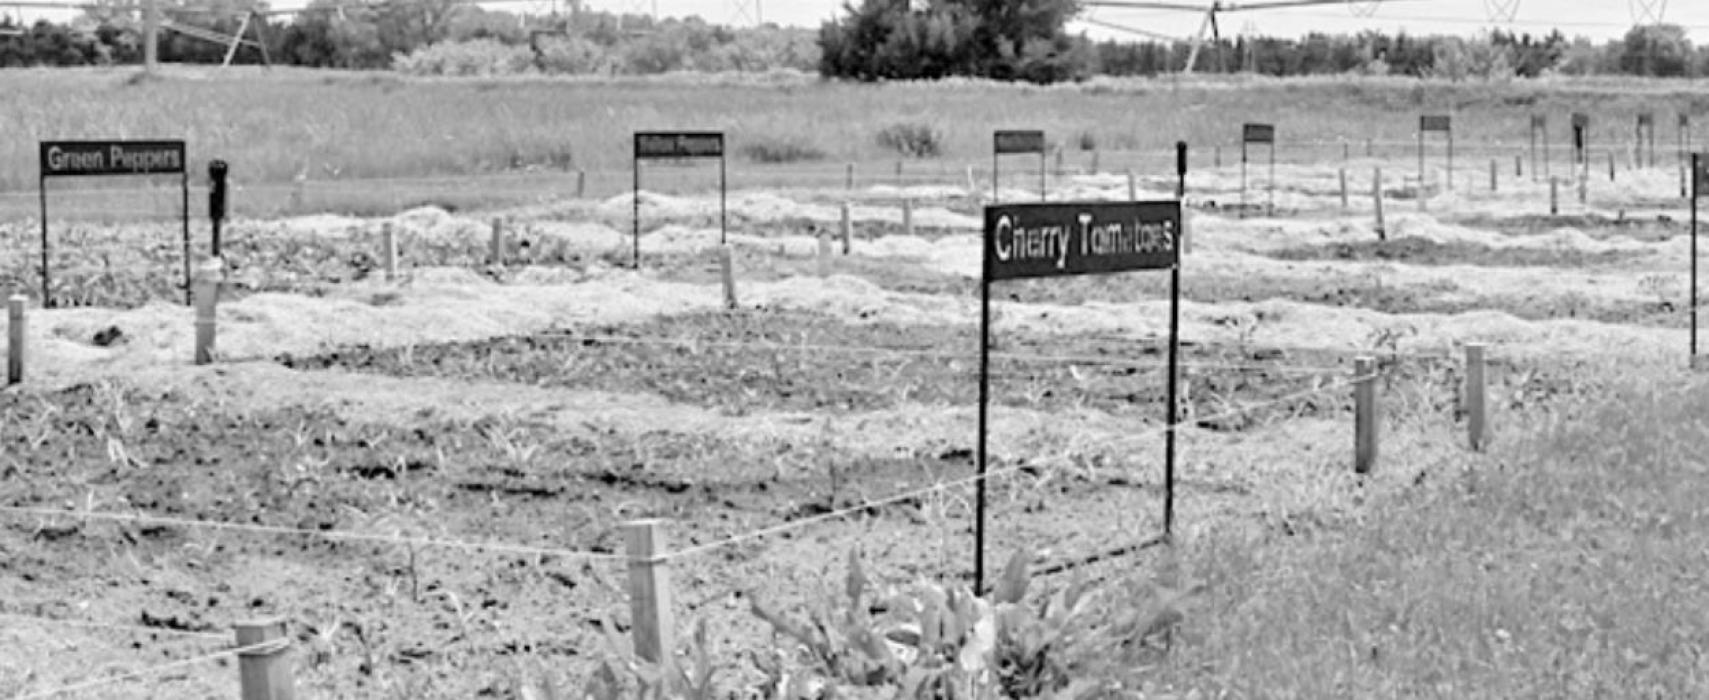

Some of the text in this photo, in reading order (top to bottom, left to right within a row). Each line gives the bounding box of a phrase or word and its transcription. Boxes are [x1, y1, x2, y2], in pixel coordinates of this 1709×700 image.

[48, 145, 179, 174] Green Peppers
[995, 214, 1070, 269] Cherry
